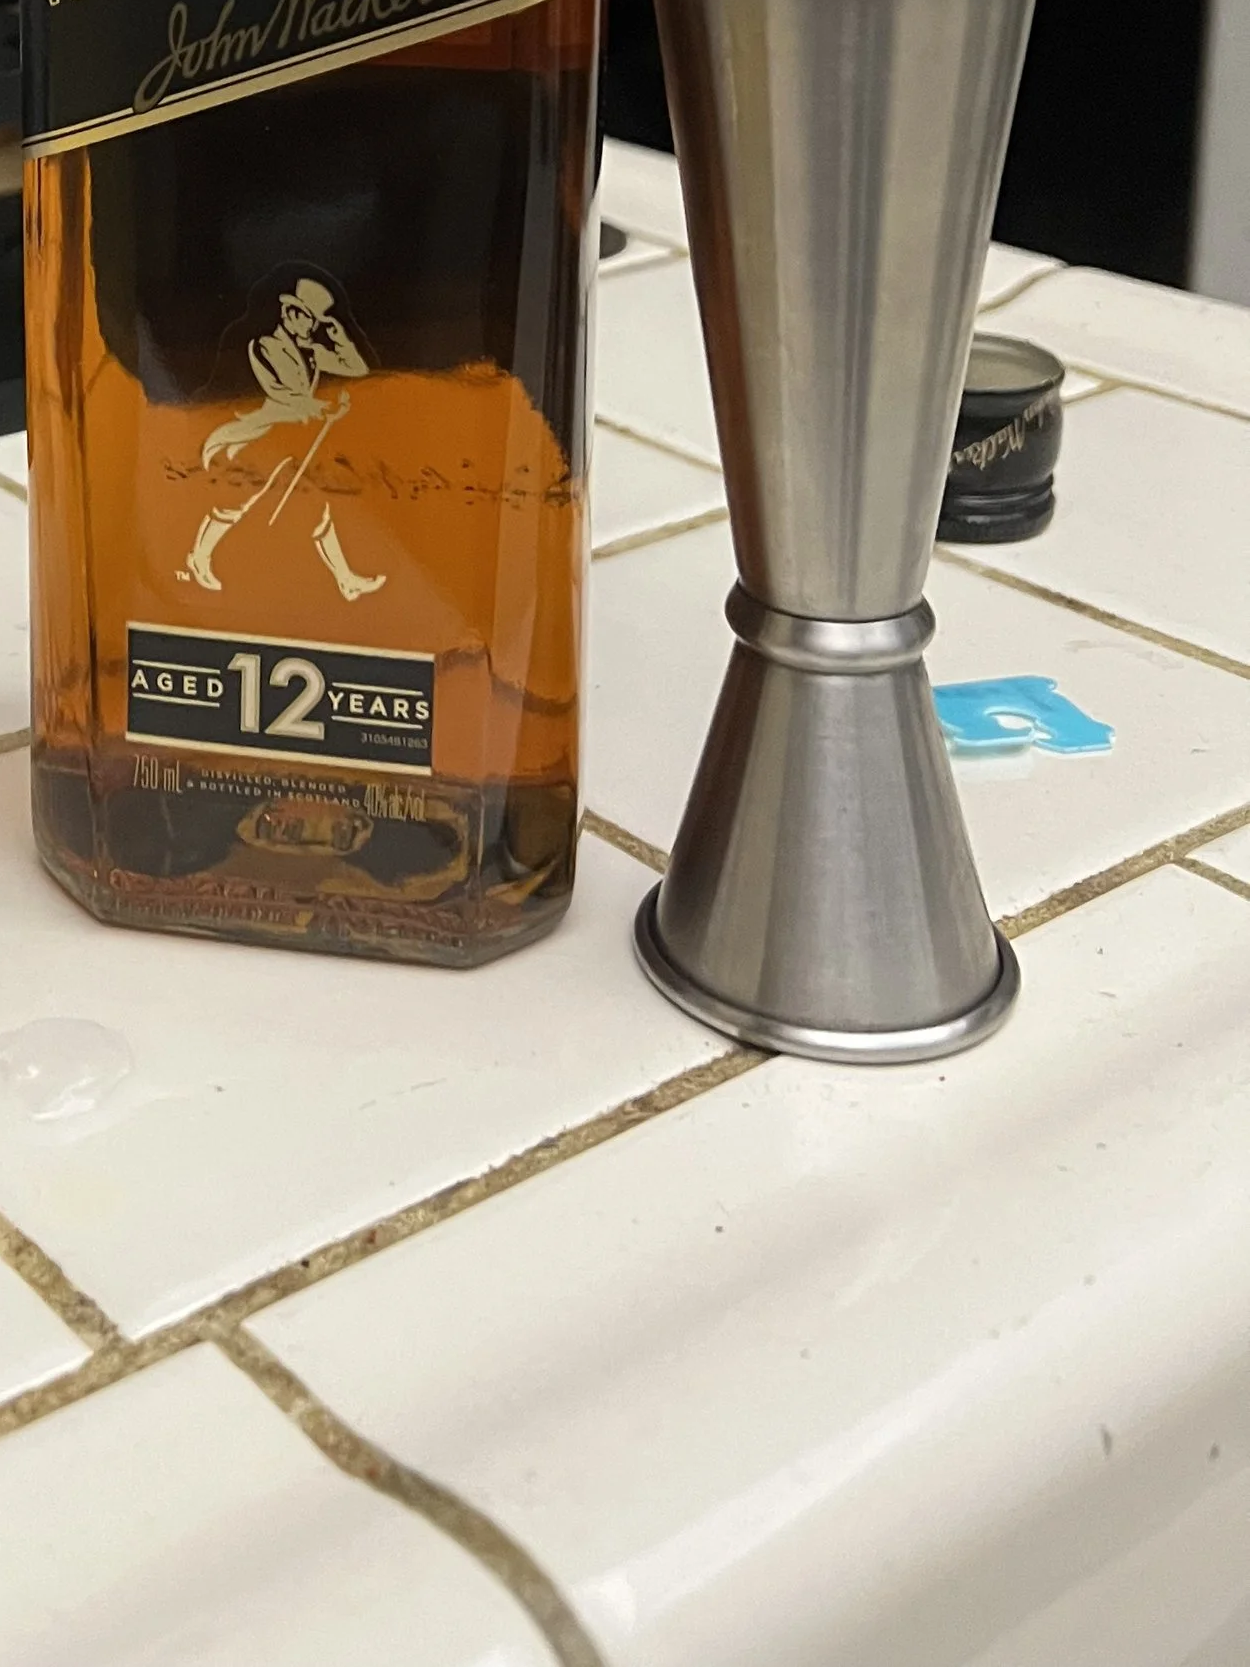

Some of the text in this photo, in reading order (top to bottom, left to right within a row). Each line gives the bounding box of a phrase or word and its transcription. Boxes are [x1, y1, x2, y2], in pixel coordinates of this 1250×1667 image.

[131, 653, 430, 740] AGED 12 YEARS
[133, 753, 159, 790] 750
[200, 781, 262, 798] BOTTLED
